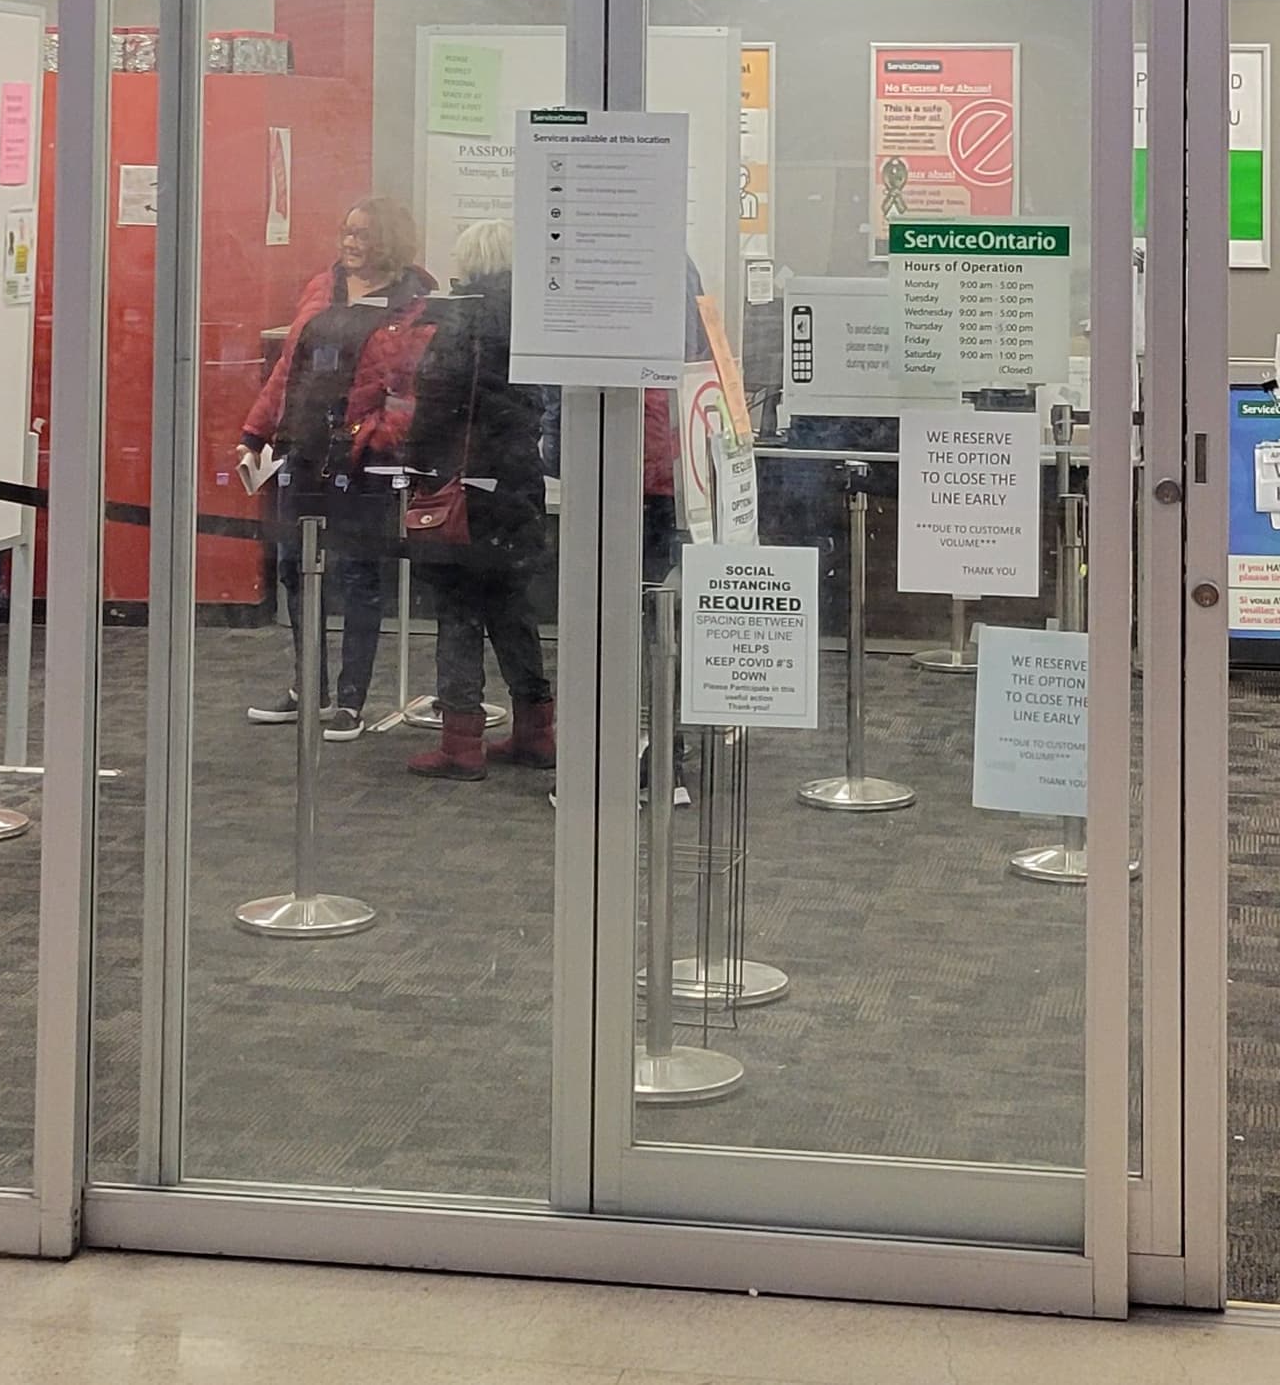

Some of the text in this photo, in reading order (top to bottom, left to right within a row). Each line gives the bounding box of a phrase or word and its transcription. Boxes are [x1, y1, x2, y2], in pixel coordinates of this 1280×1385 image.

[885, 84, 992, 93] No Excuse for Abuse!
[533, 133, 569, 143] Services
[571, 135, 607, 143] available
[619, 135, 635, 143] this
[637, 136, 670, 144] location
[904, 230, 1057, 251] ServiceOntario
[904, 260, 1023, 275] Hours of Operation
[904, 279, 1034, 292] Monday 9:00 am 5:00 pm
[904, 293, 1034, 306] Tuesday 9:00 am 5:00 pm
[904, 307, 1034, 320] Wednesday 9:00 am 5:00 pm
[904, 321, 1034, 334] Thursday 9:00 am 5:00 pm
[904, 336, 1034, 348] Friday 9:00 am 5:00 pm
[904, 350, 942, 361] Saturday
[959, 351, 978, 360] 9:00
[999, 351, 1018, 360] 1:00
[1019, 353, 1034, 362] pm
[904, 363, 1033, 375] Sunday (Closed)
[652, 373, 677, 381] Ontario
[927, 431, 1012, 445] WE RESERVE
[928, 452, 1011, 465] THE OPTION
[921, 471, 1017, 486] TO CLOSE THE
[931, 492, 1007, 506] LINE EARLY
[955, 525, 967, 534] TO
[969, 525, 1021, 535] CUSTOMER
[726, 566, 774, 576] SOCIAL
[962, 566, 1017, 576] THANK YOU
[709, 580, 791, 591] DISTANCING
[699, 595, 802, 612] REQUIRED
[1239, 596, 1248, 605] Si
[696, 615, 804, 627] SPACING BETWEEN
[706, 630, 792, 641] PEOPLE IN LINE
[733, 644, 769, 654] HELPS
[705, 656, 793, 669] KEEP COVID #'S
[1011, 655, 1087, 671] WE RESERVE
[732, 671, 767, 681] DOWN
[1012, 674, 1085, 689] THE OPTION
